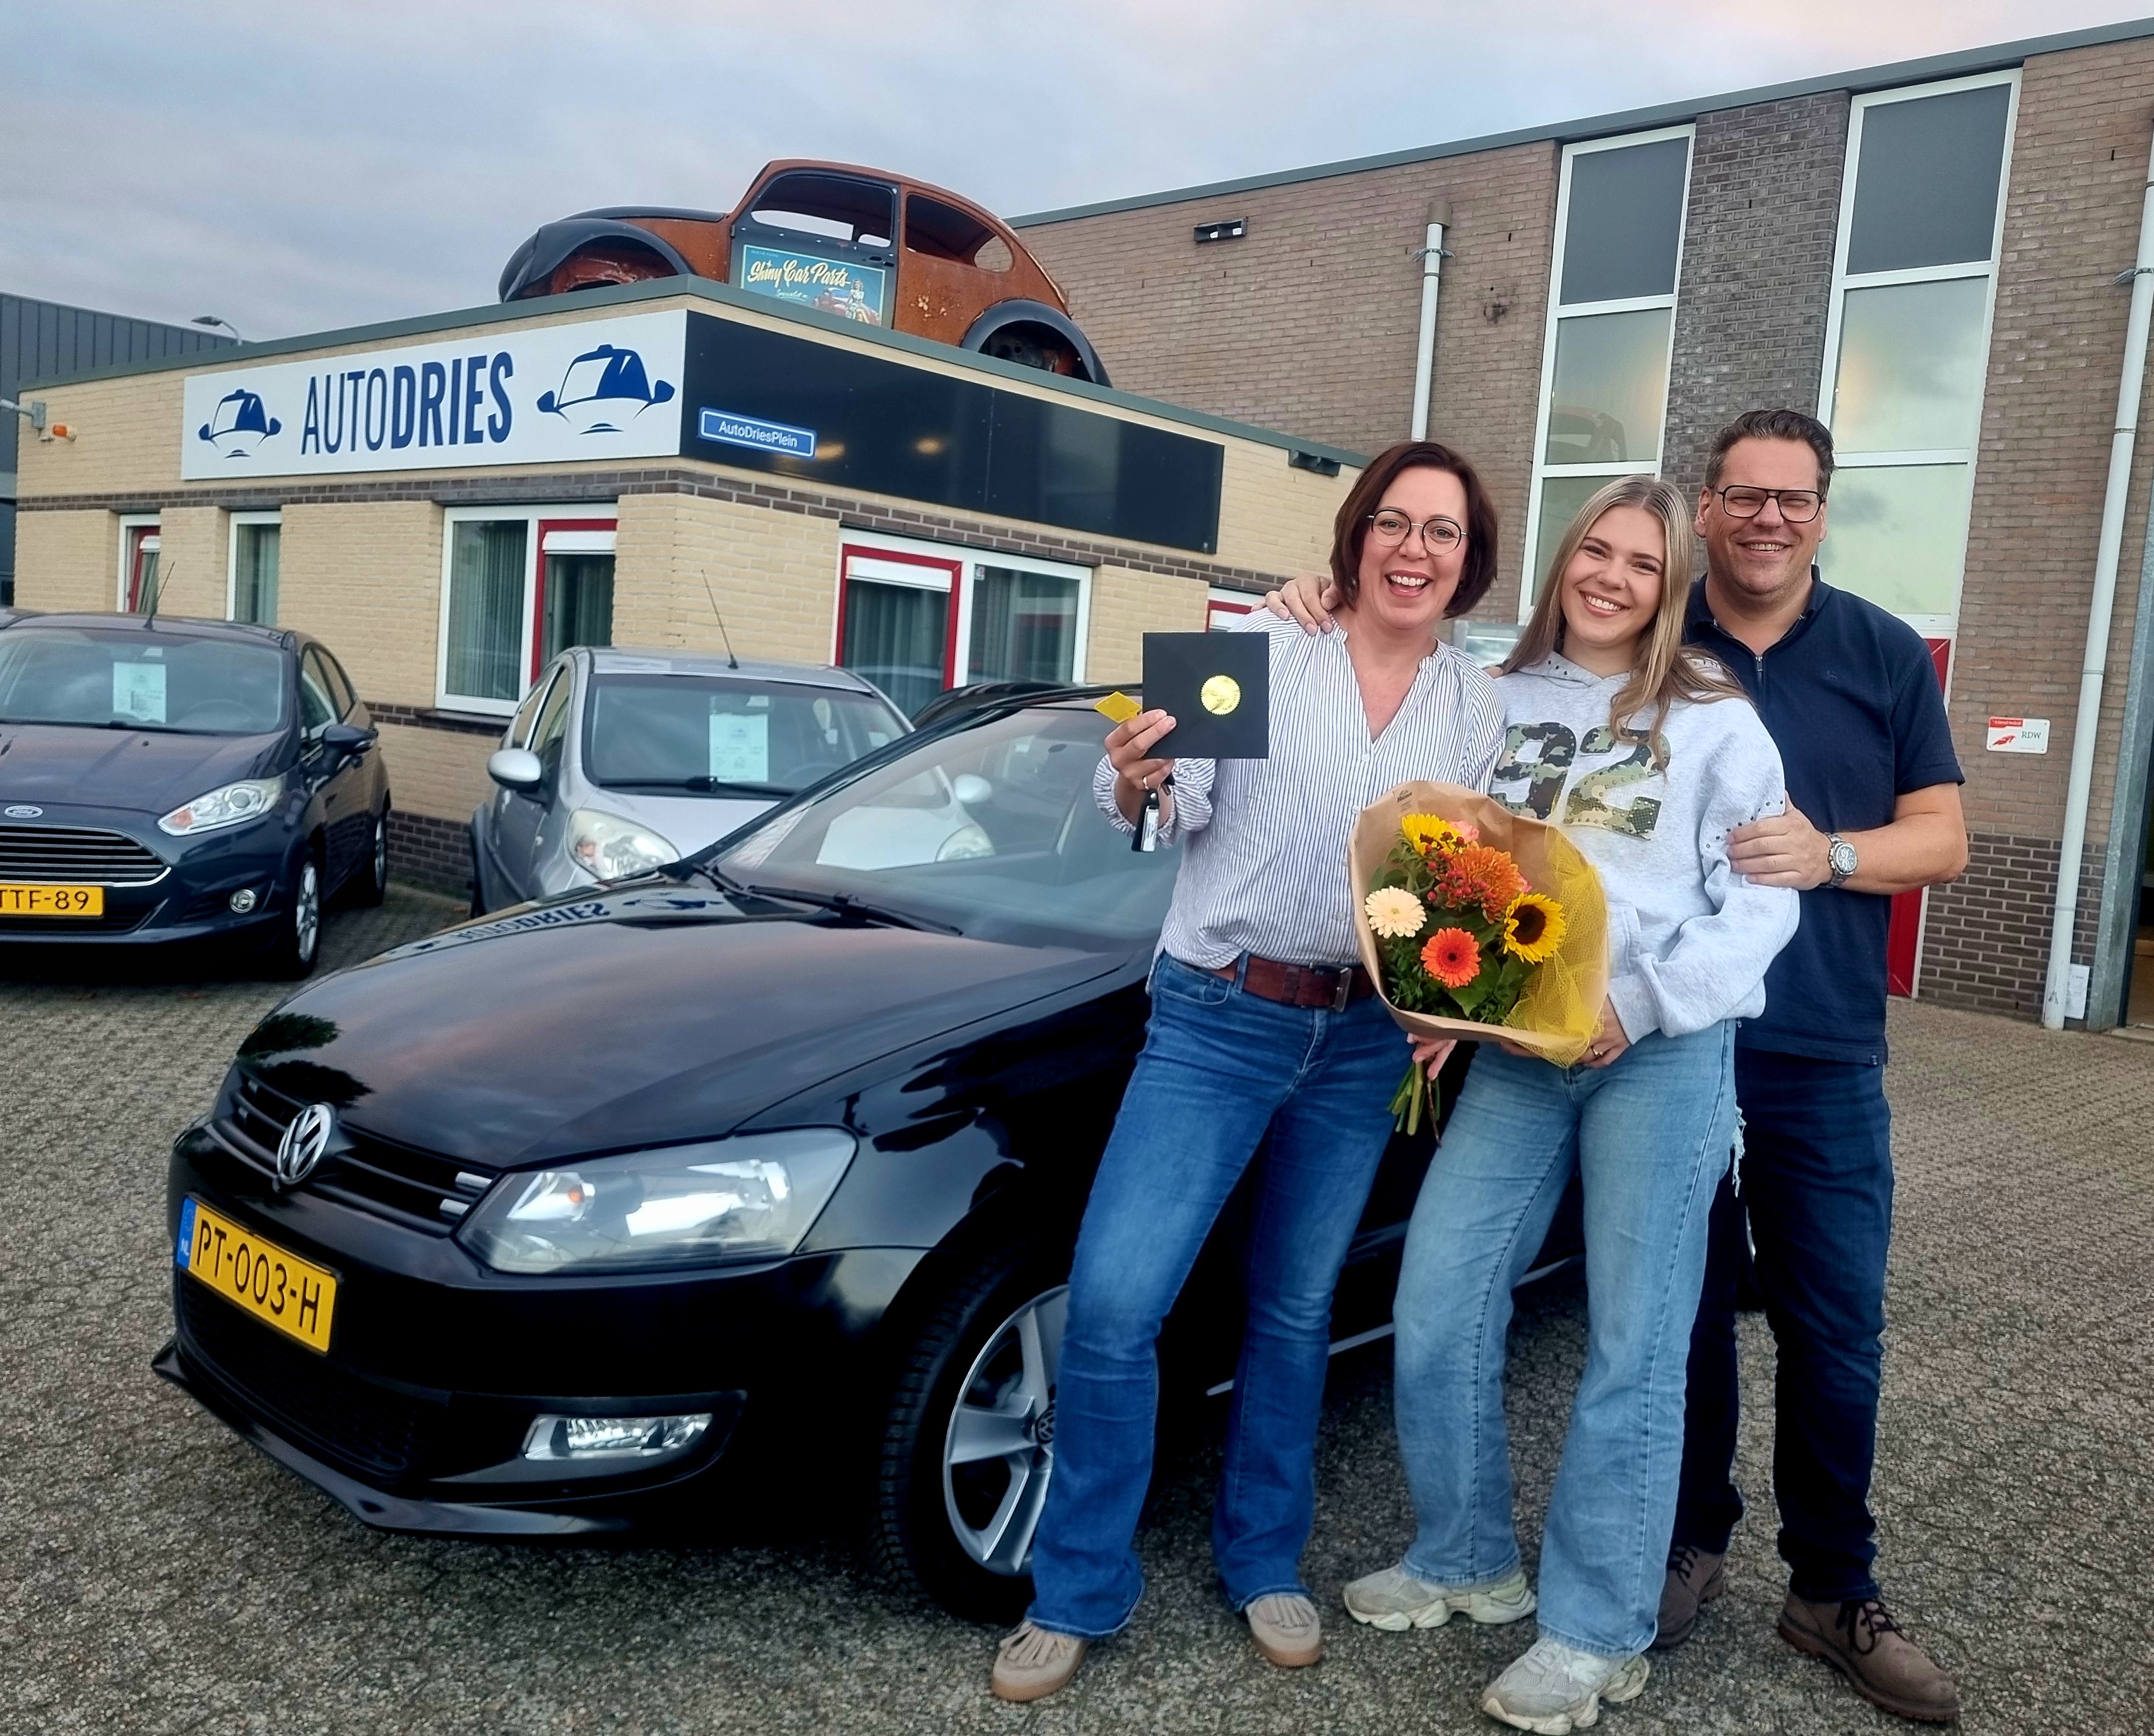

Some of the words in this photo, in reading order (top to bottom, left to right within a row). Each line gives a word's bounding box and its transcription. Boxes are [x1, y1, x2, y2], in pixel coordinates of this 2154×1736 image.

[747, 260, 783, 288] Shiny
[783, 259, 810, 288] Car
[810, 263, 851, 286] Parts
[300, 351, 514, 455] AUTODRIES
[718, 420, 798, 447] AutoDriesPlein
[1488, 722, 1671, 841] 92
[197, 1219, 321, 1335] PT-003-H
